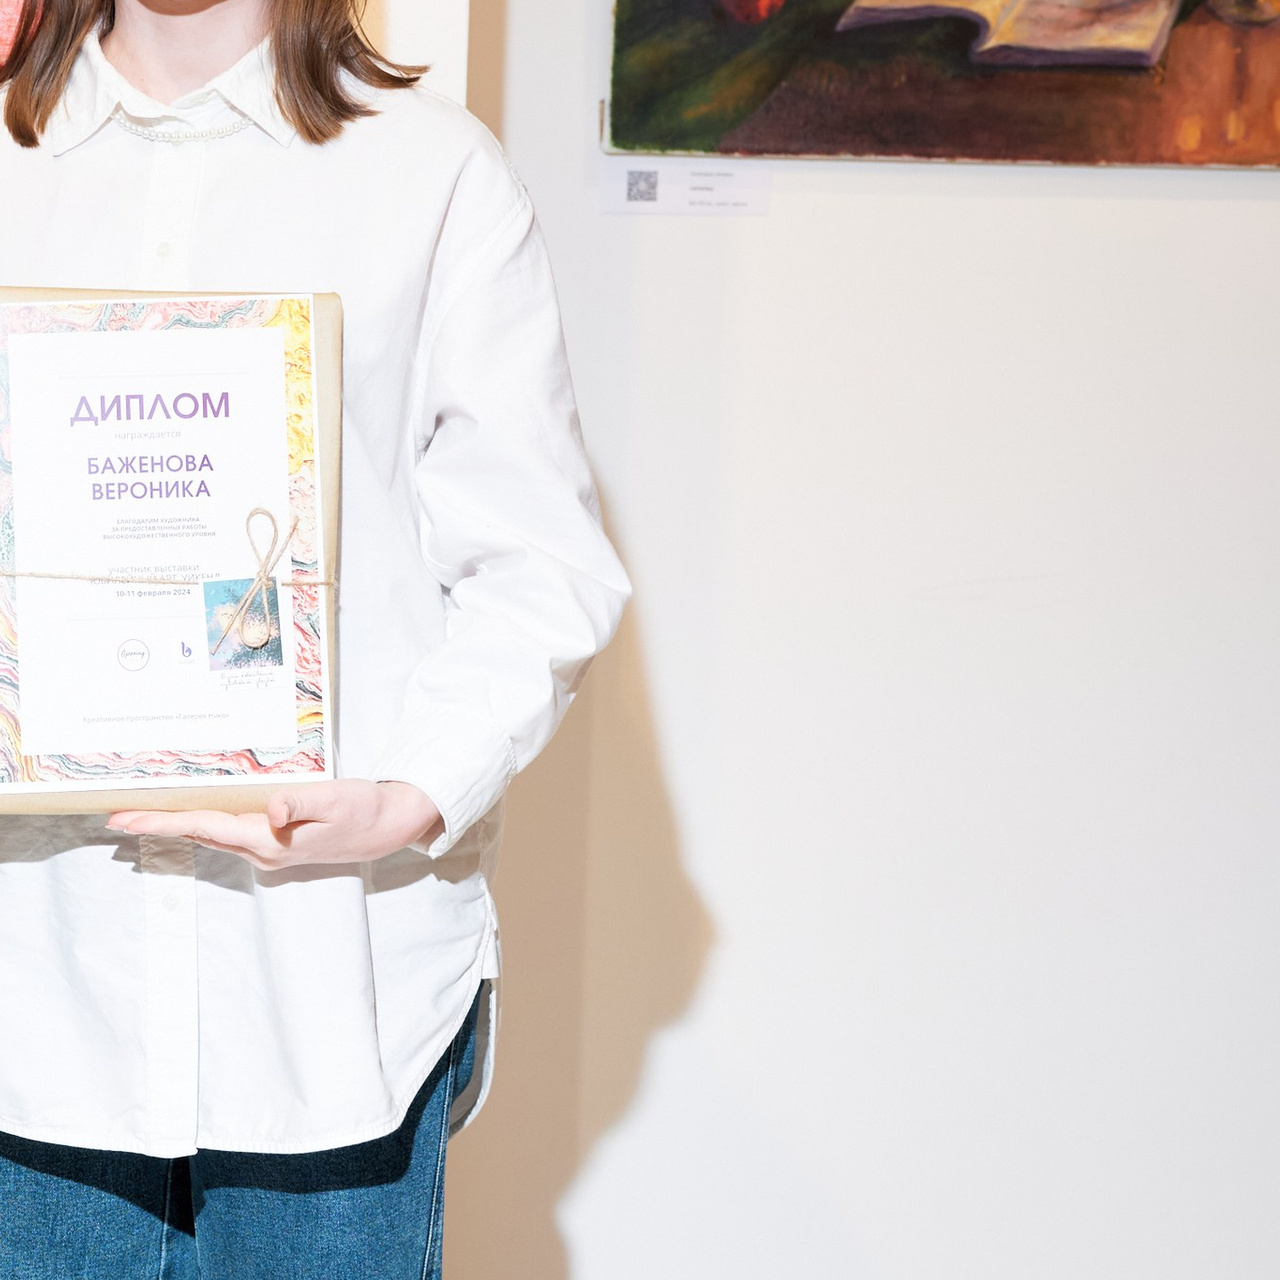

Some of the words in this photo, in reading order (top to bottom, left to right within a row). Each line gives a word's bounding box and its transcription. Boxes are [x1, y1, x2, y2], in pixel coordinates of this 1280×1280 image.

[70, 392, 230, 427] ДИПЛОМ
[114, 430, 181, 442] награждается
[87, 454, 214, 475] БАЖЕНОВА
[92, 480, 211, 501] ВЕРОНИКА
[160, 516, 200, 524] ХУДОЖНИКА
[191, 530, 216, 538] УРОВНЯ
[108, 565, 152, 576] участник
[154, 564, 200, 573] выставки
[137, 590, 171, 598] февраля
[173, 588, 191, 596] 2024
